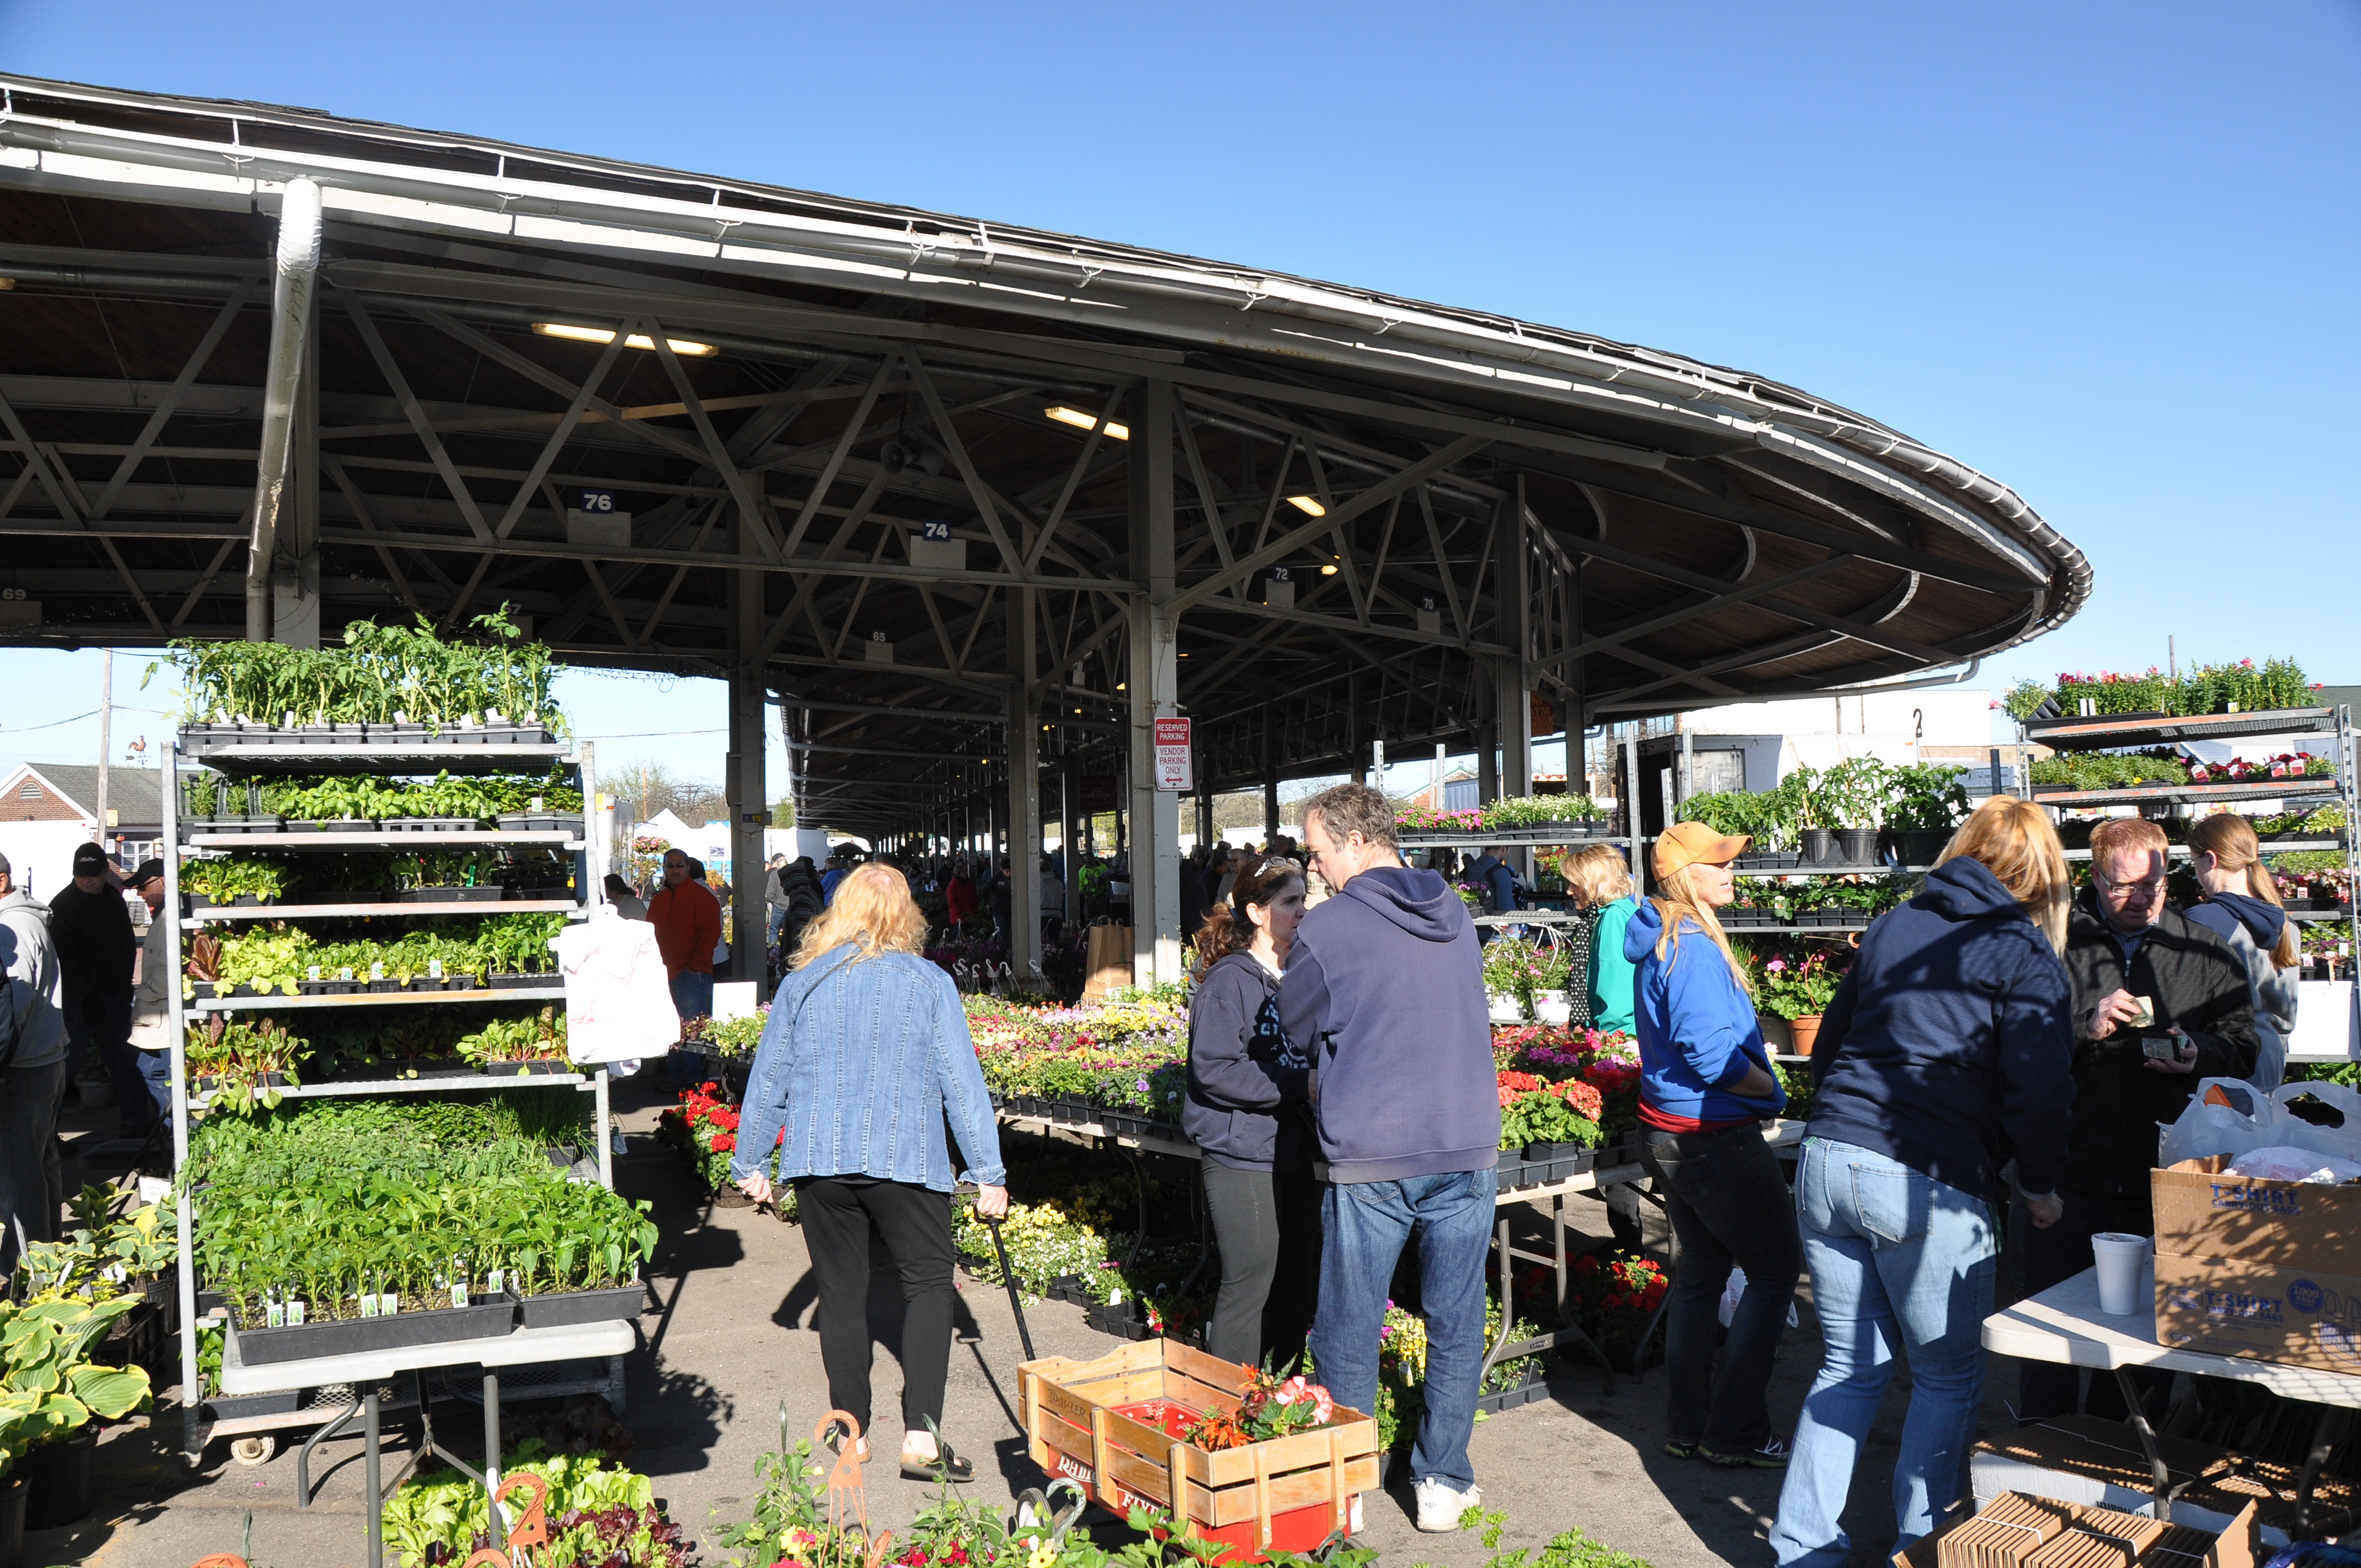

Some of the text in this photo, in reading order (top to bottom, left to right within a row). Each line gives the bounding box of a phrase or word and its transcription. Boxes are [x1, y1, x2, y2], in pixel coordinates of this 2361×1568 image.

[584, 494, 612, 511] 76
[925, 522, 948, 538] 74
[1275, 567, 1288, 580] 72
[2, 588, 26, 601] 69
[1424, 598, 1434, 609] 70
[873, 631, 885, 642] 65
[1157, 723, 1188, 732] RESERVED
[1160, 732, 1185, 741] PARKING
[1160, 747, 1185, 755] VENDOR
[1159, 756, 1187, 765] PARKING
[1165, 766, 1181, 774] ONLY
[2210, 1184, 2298, 1206] T-SHIRT
[2211, 1199, 2300, 1215] CARRY-OUT BAGS
[2293, 1286, 2319, 1299] 1000
[2204, 1291, 2283, 1313] T-SHIRT
[2206, 1305, 2284, 1322] CARRY-OUT BAGS
